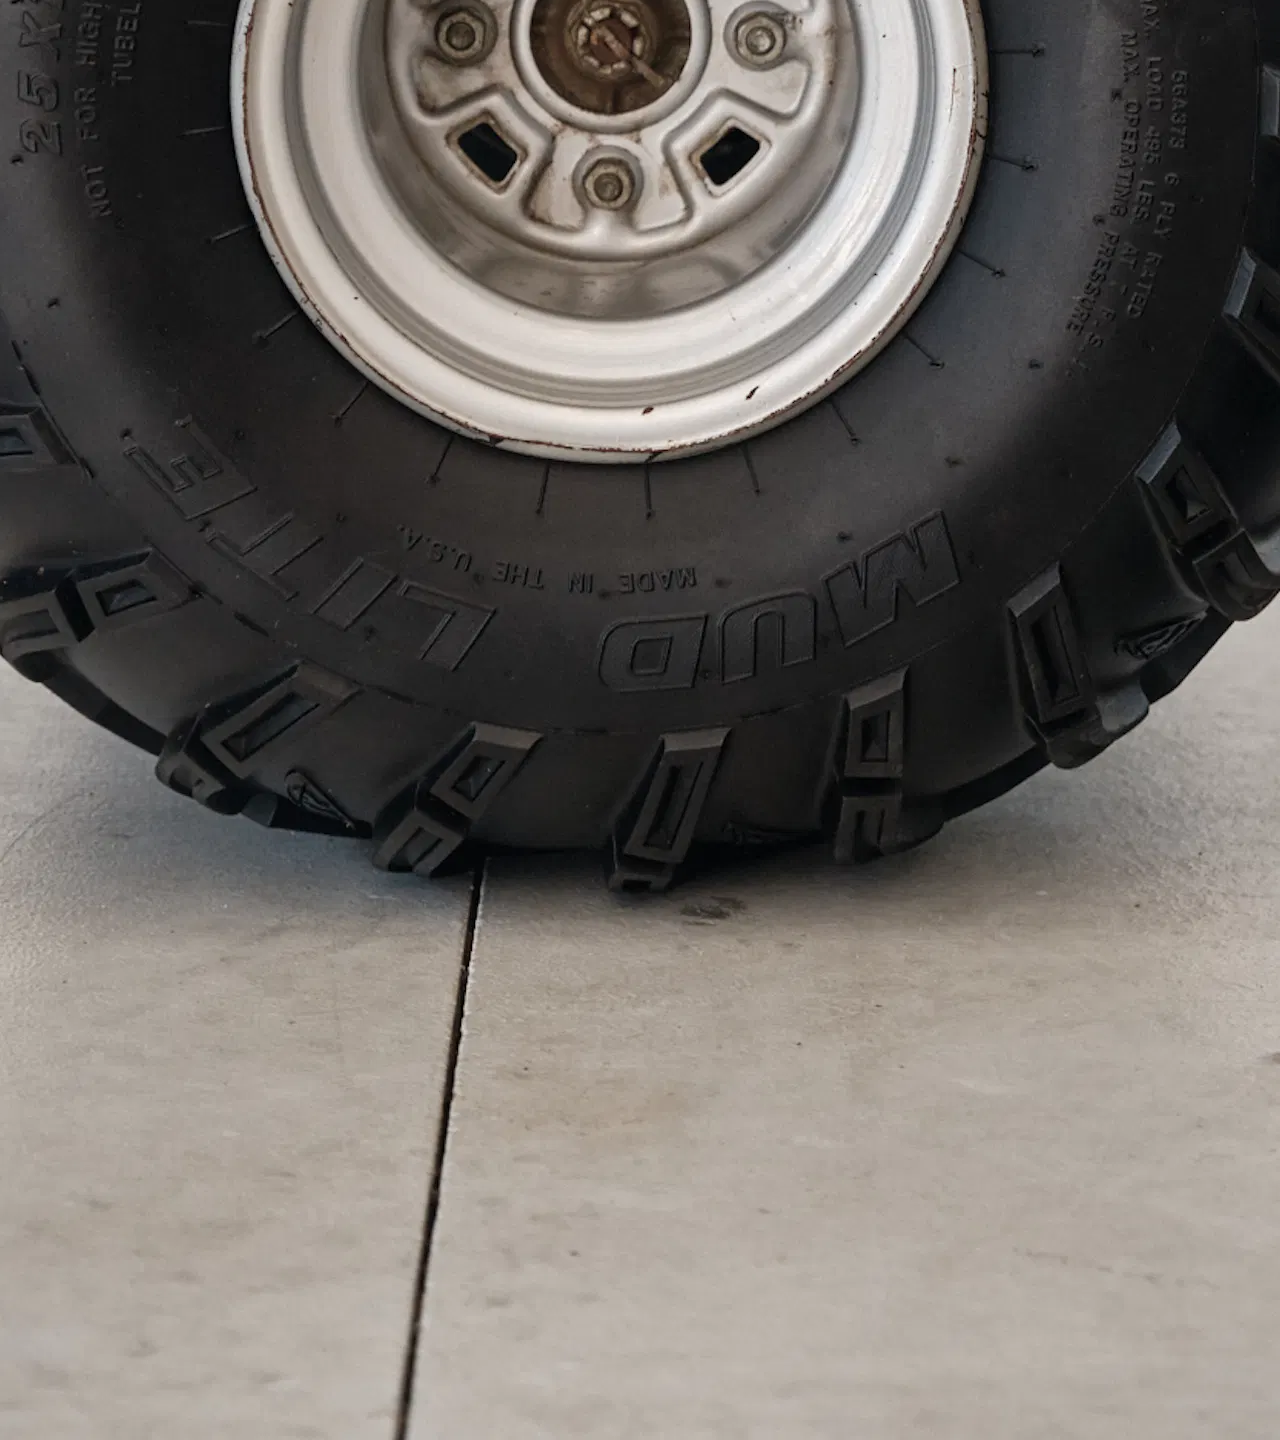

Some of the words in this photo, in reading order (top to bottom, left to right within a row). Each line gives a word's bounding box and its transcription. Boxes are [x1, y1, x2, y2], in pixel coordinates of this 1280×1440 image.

[1121, 29, 1141, 82] MAX.
[1145, 56, 1165, 113] LOAD
[74, 87, 99, 141] FOR
[1108, 98, 1142, 219] OPERATING
[81, 163, 113, 218] NOT
[1153, 200, 1177, 240] PLY
[1065, 230, 1120, 337] PRESSURE
[121, 413, 500, 672] LITE
[396, 523, 473, 573] U.S.A.
[491, 560, 544, 592] THE
[567, 570, 594, 594] IN
[598, 508, 962, 692] MUD
[619, 566, 699, 595] MADE
